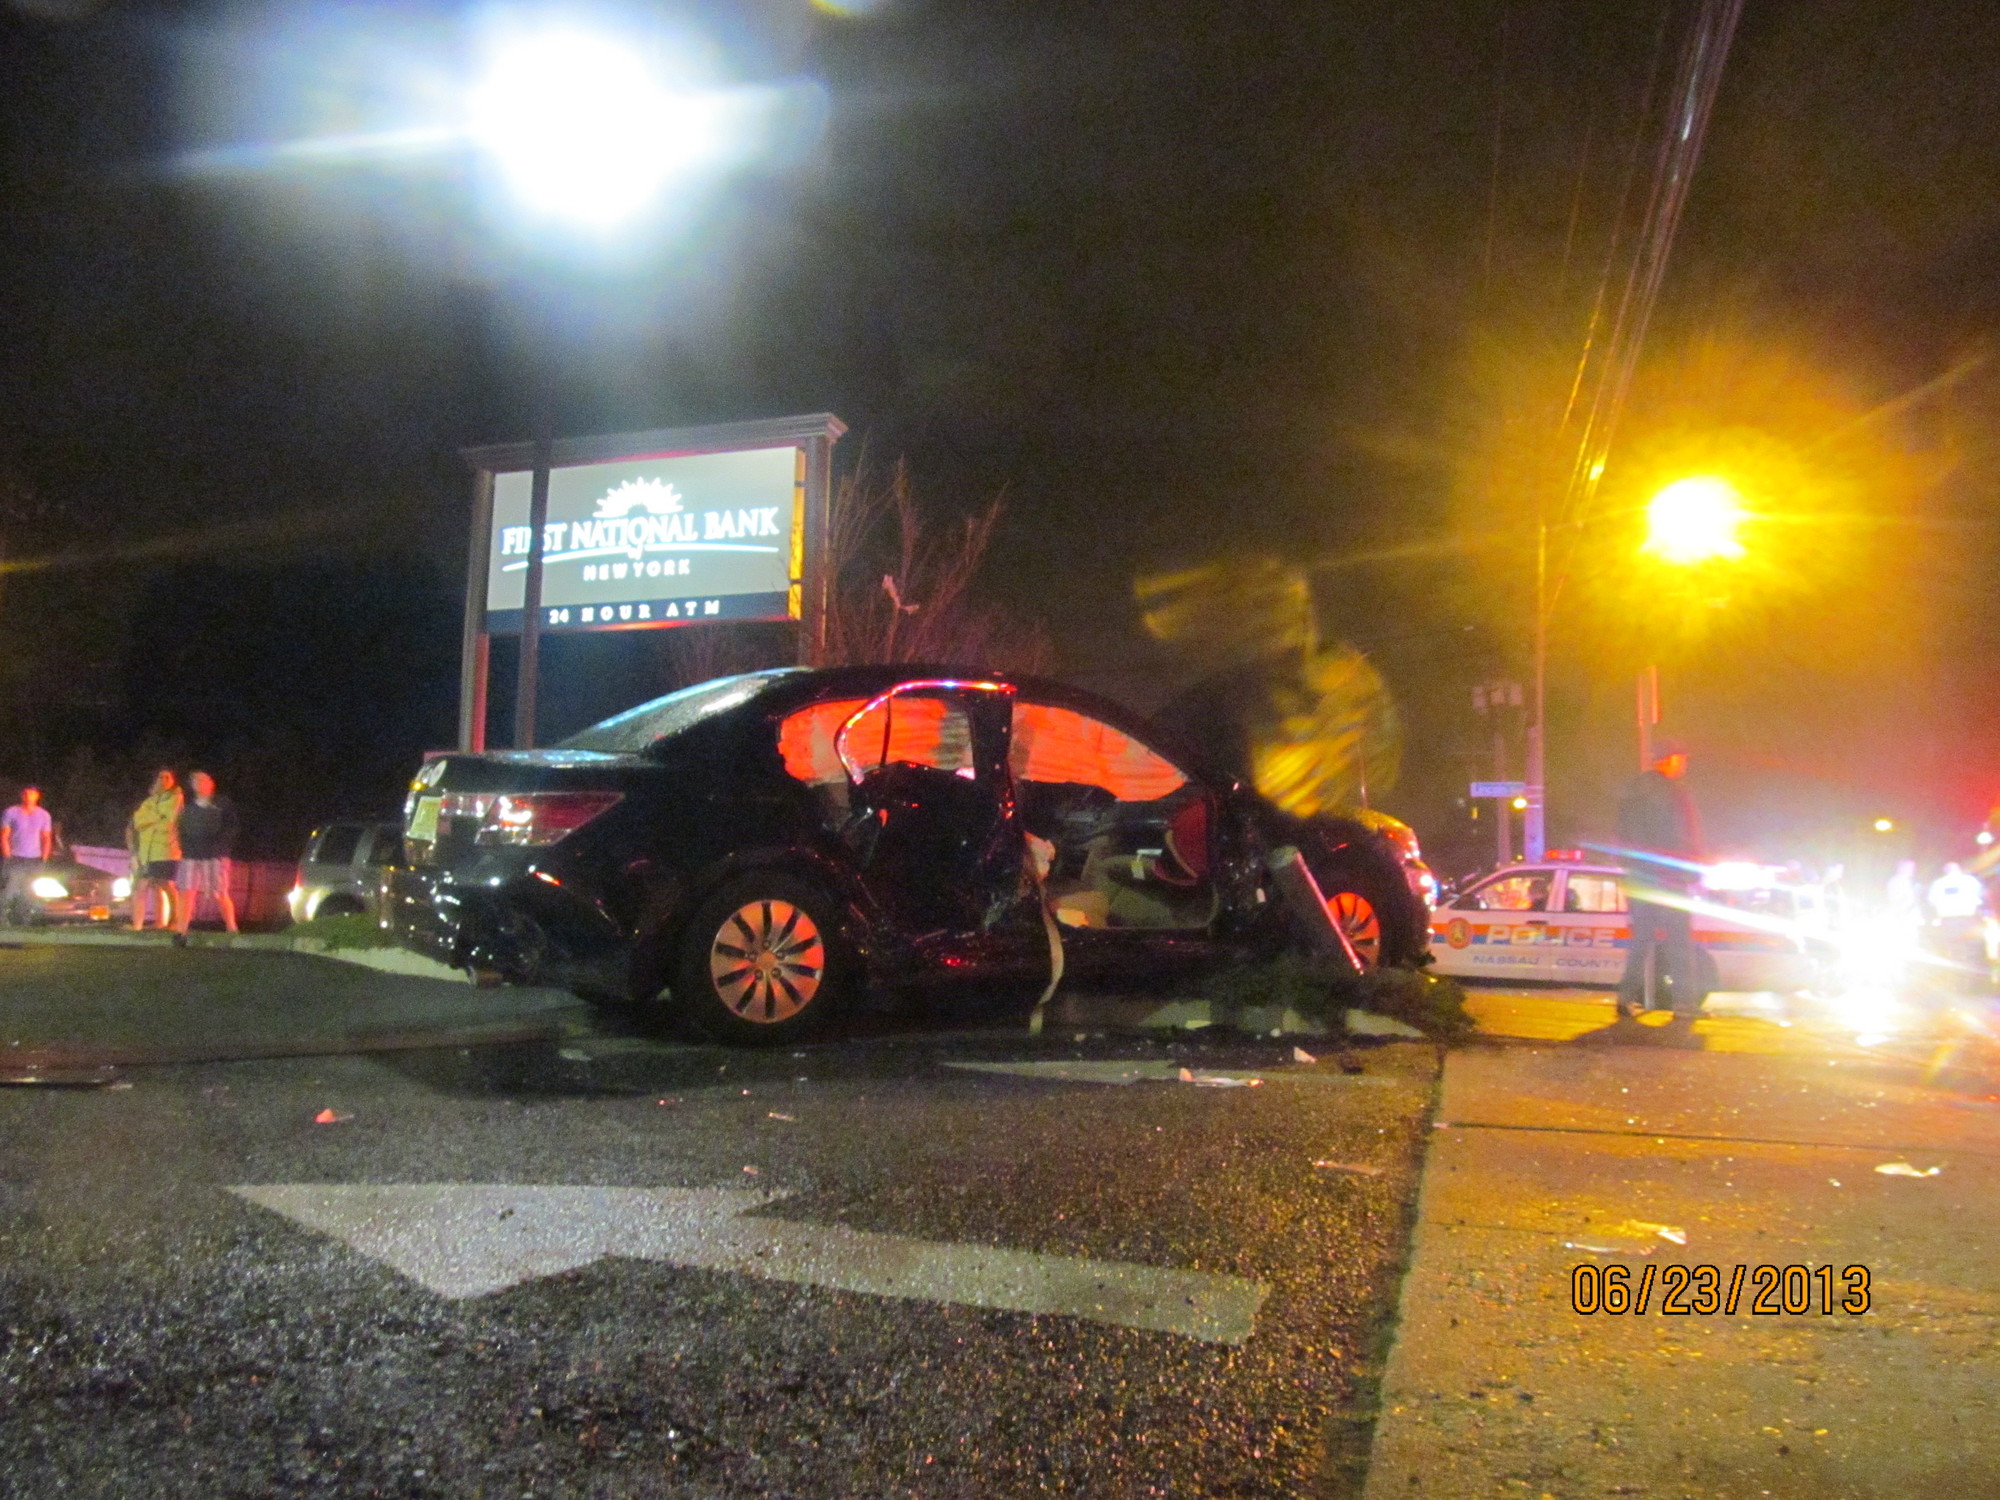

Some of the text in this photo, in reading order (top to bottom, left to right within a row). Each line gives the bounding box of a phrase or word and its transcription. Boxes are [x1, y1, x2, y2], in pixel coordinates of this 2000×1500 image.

[569, 513, 699, 550] NATIONAL
[704, 507, 780, 540] BANK
[583, 559, 690, 581] NEW YORK
[549, 599, 720, 624] 24 HOUR ATM
[1486, 924, 1616, 947] POLICE
[1473, 954, 1623, 968] NASSAU COUNTY
